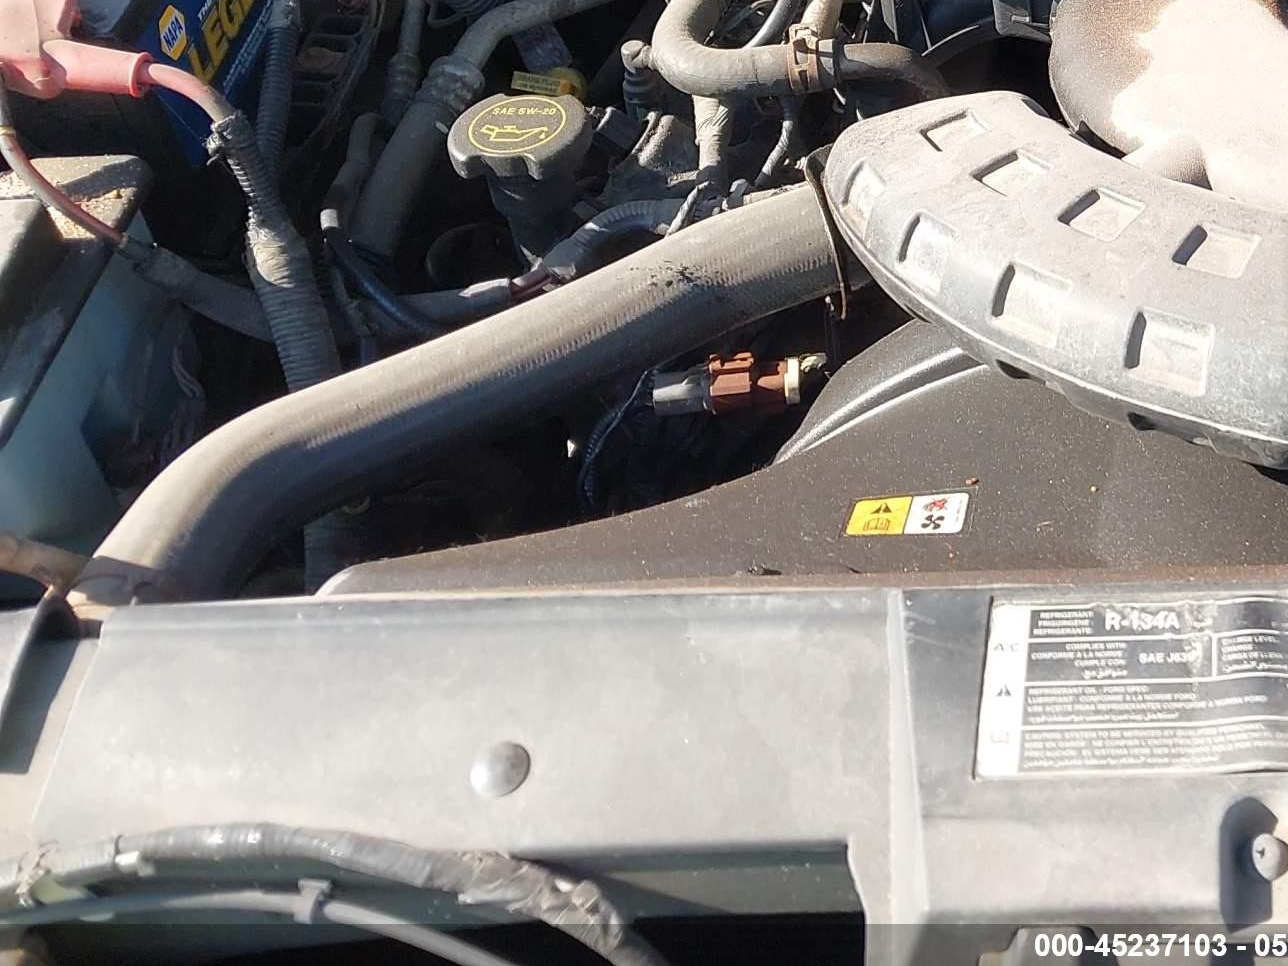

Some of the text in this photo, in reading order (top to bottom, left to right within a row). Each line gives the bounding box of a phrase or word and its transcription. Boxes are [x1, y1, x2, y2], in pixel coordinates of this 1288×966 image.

[162, 16, 184, 51] NAPA
[492, 107, 557, 115] SAE 5W-20
[1105, 608, 1179, 631] R-134A
[1139, 652, 1164, 664] SAE
